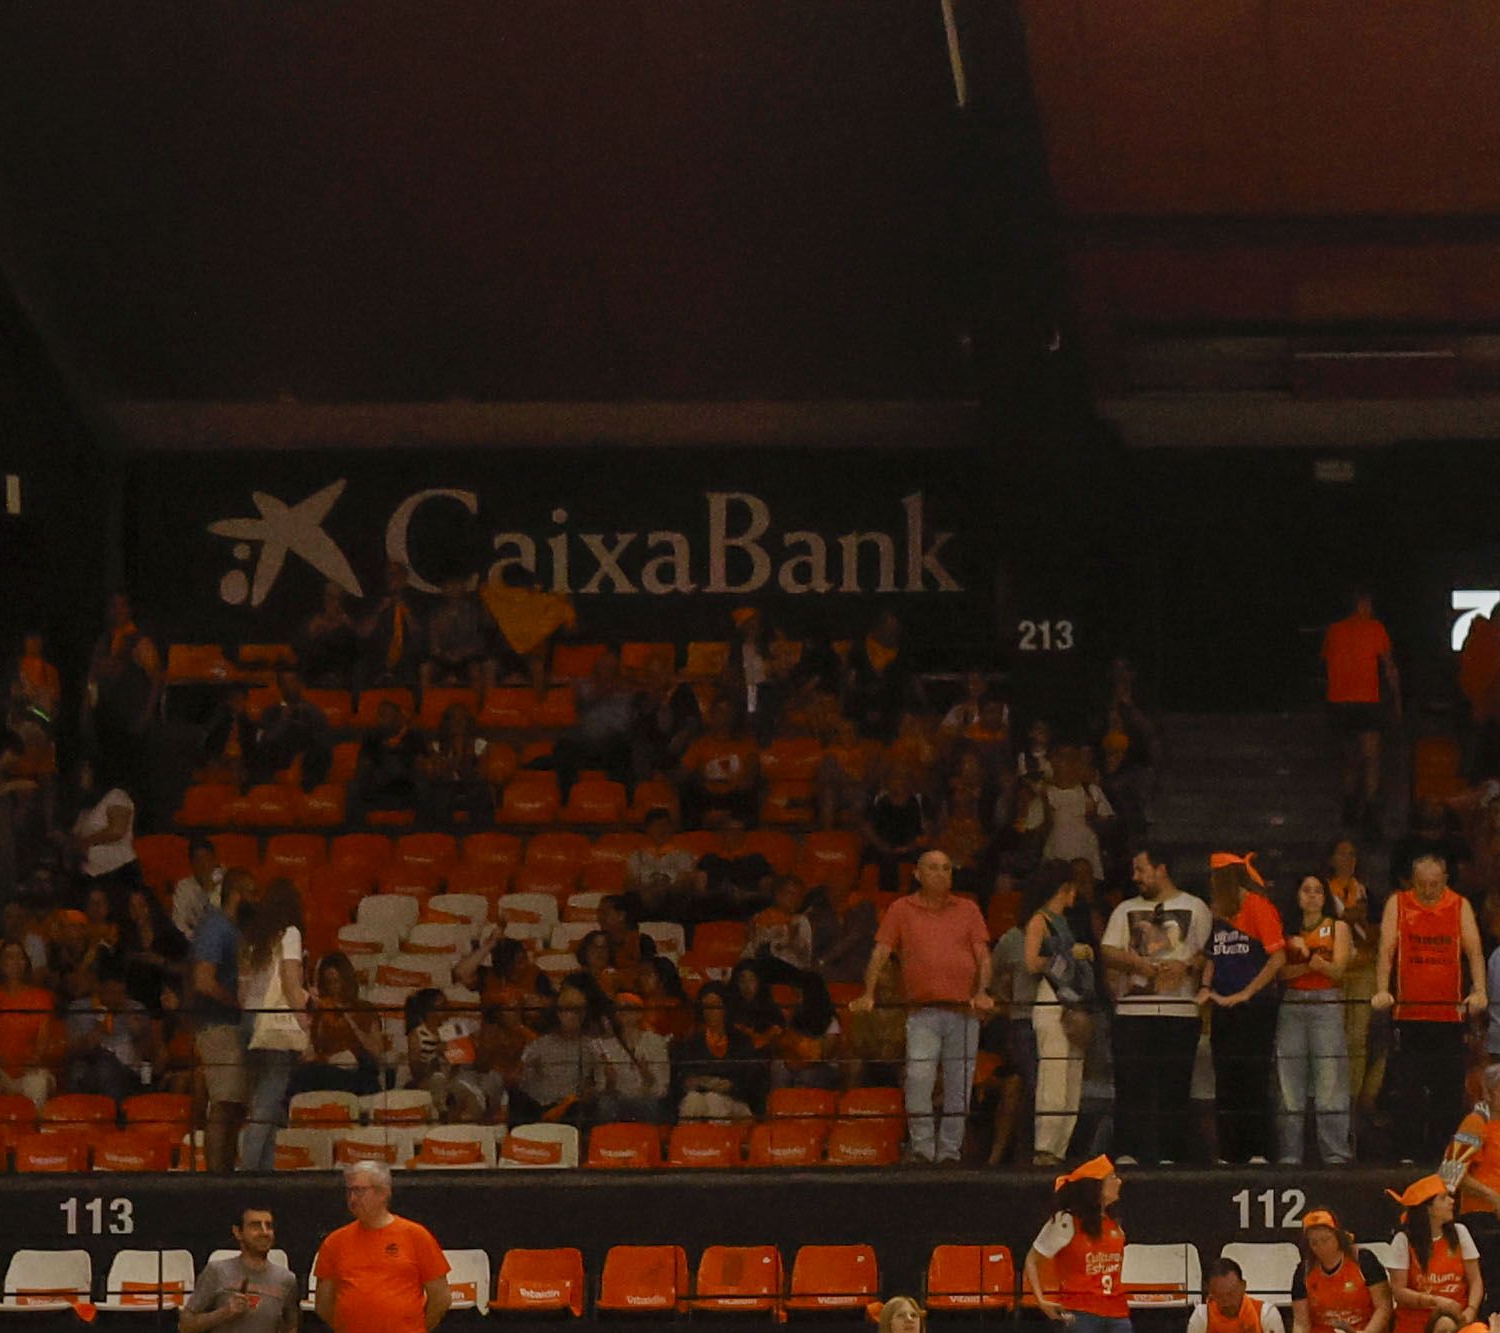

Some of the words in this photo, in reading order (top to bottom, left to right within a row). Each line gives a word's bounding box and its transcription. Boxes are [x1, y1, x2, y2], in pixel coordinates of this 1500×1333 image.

[384, 488, 962, 594] CaixaBank
[1018, 621, 1074, 651] 213
[59, 1198, 135, 1235] 113
[1232, 1189, 1306, 1229] 112
[518, 1287, 560, 1299] Vitaldin
